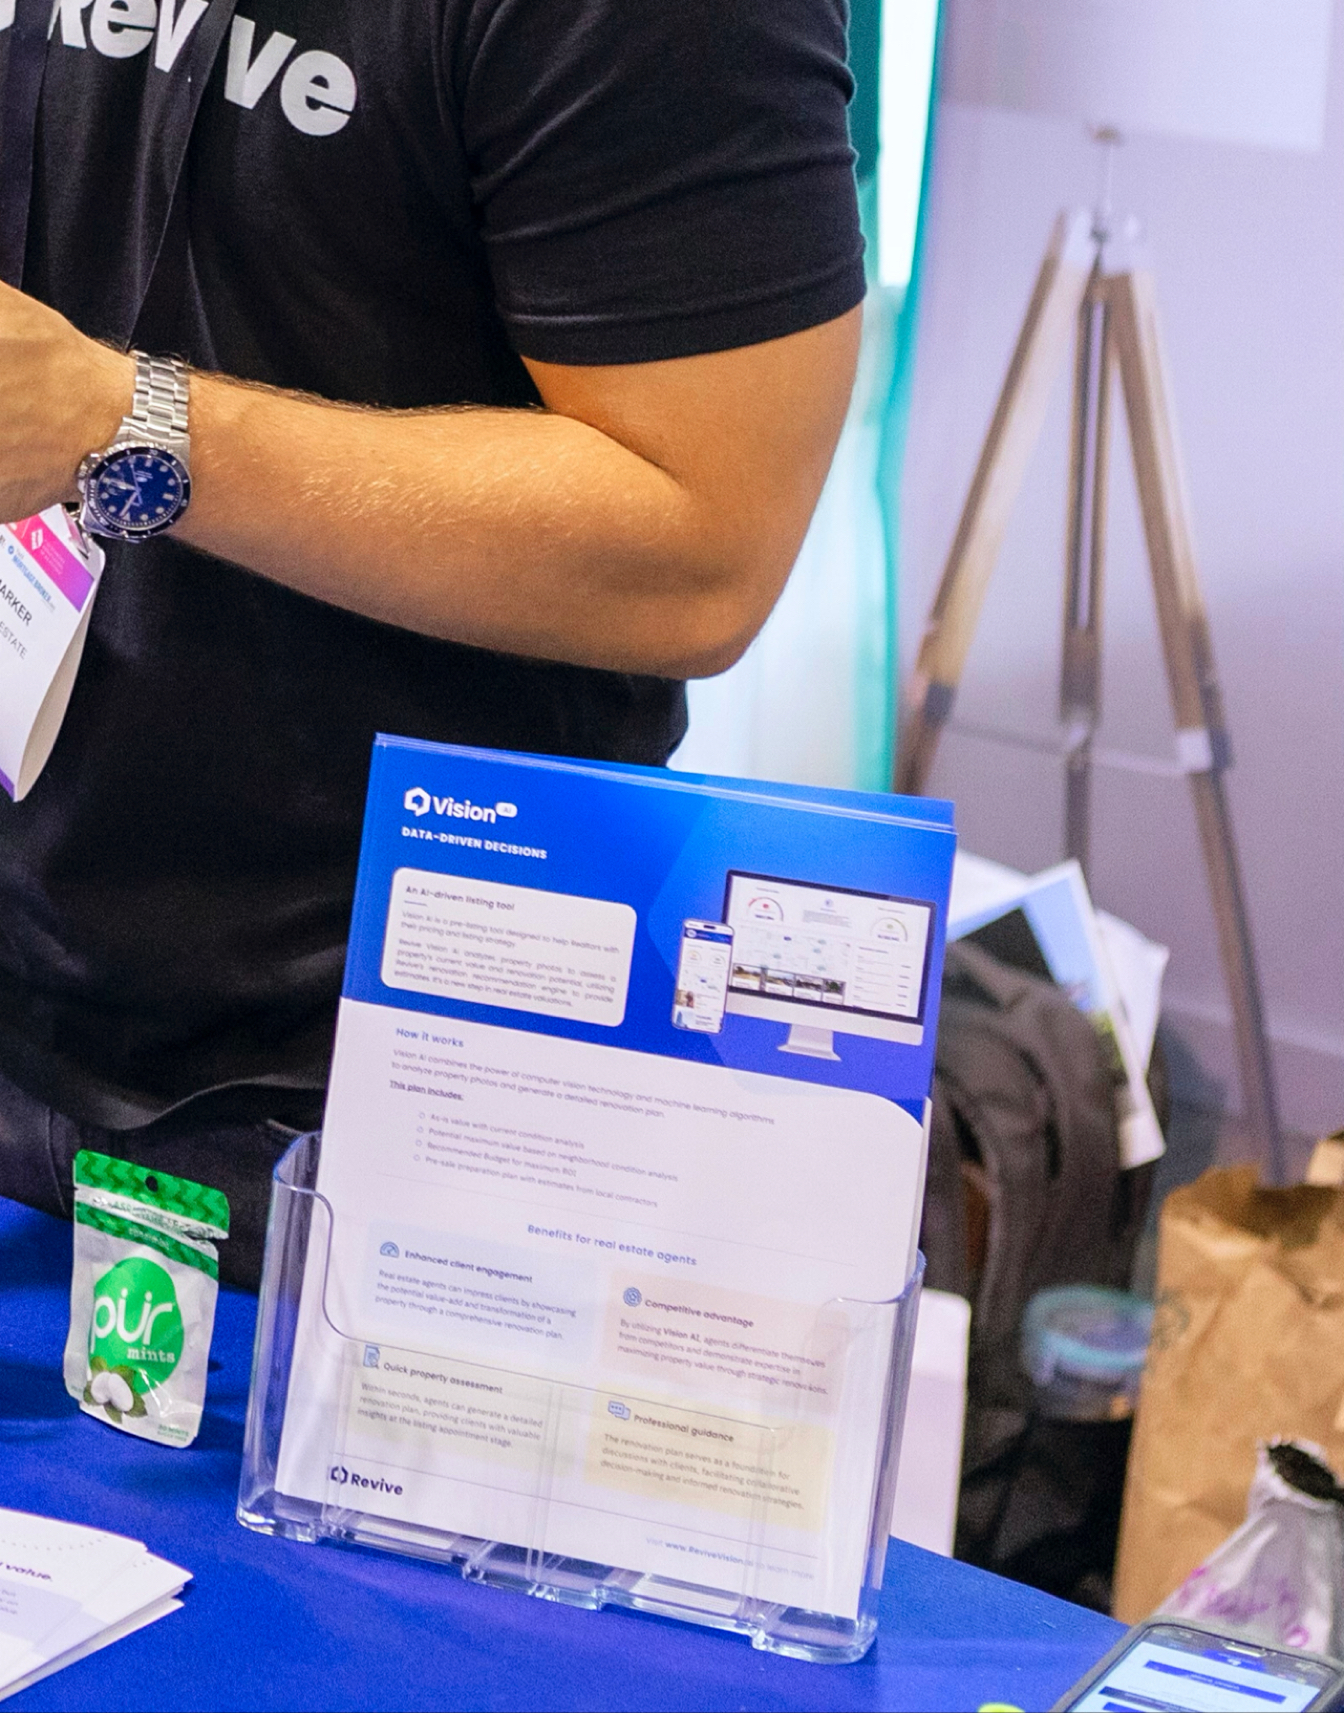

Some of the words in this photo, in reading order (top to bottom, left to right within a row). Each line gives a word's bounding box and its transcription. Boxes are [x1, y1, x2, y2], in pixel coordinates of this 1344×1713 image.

[432, 796, 498, 823] Vision
[401, 826, 482, 848] DATA-DRIVEN
[483, 839, 547, 859] DECISIONS
[396, 1028, 418, 1038] How
[421, 1031, 428, 1041] it
[431, 1035, 463, 1047] works
[527, 1224, 572, 1240] Benefits
[575, 1233, 591, 1243] for
[594, 1238, 615, 1248] real
[618, 1243, 654, 1257] estate
[656, 1251, 696, 1265] agents
[404, 1250, 448, 1265] Enhanced
[449, 1260, 474, 1271] client
[475, 1266, 532, 1282] engagement
[644, 1299, 701, 1316] Competitive
[703, 1311, 753, 1328] advantage
[126, 1348, 176, 1364] mints
[409, 1368, 447, 1383] property
[633, 1414, 689, 1432] Professional
[690, 1427, 733, 1442] guidance
[350, 1473, 402, 1495] Revive
